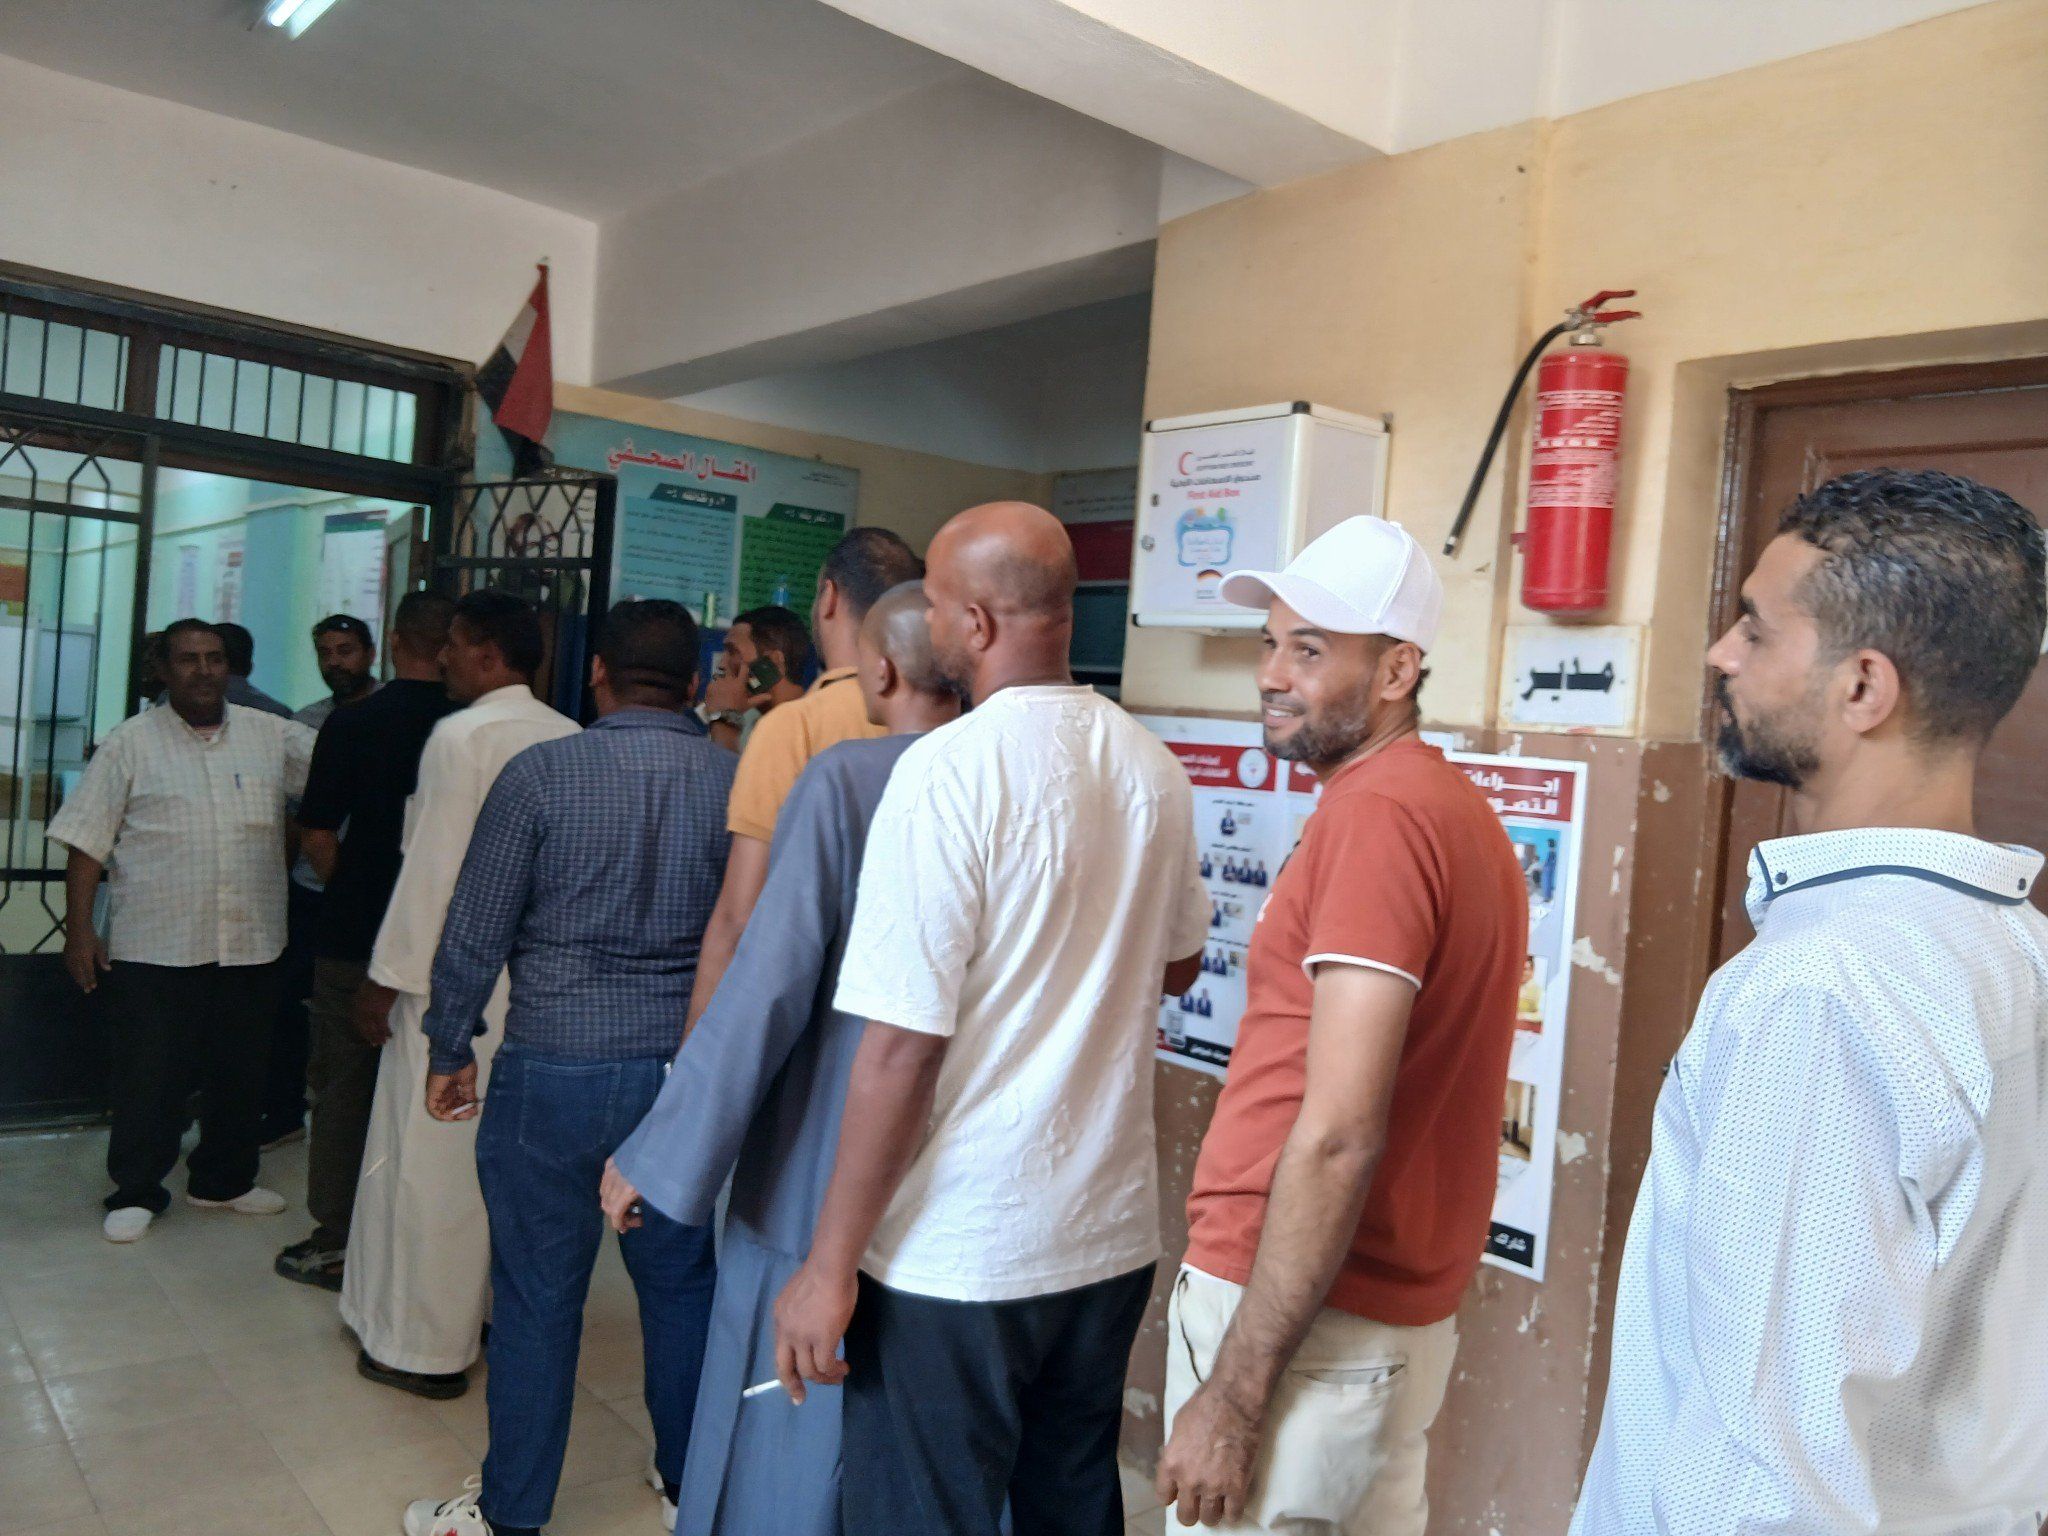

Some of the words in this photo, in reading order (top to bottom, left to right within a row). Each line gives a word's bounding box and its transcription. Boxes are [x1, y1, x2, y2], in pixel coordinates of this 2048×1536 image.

[607, 437, 695, 473] الصحفي
[697, 455, 756, 483] المقال
[1520, 656, 1615, 701] مدير
